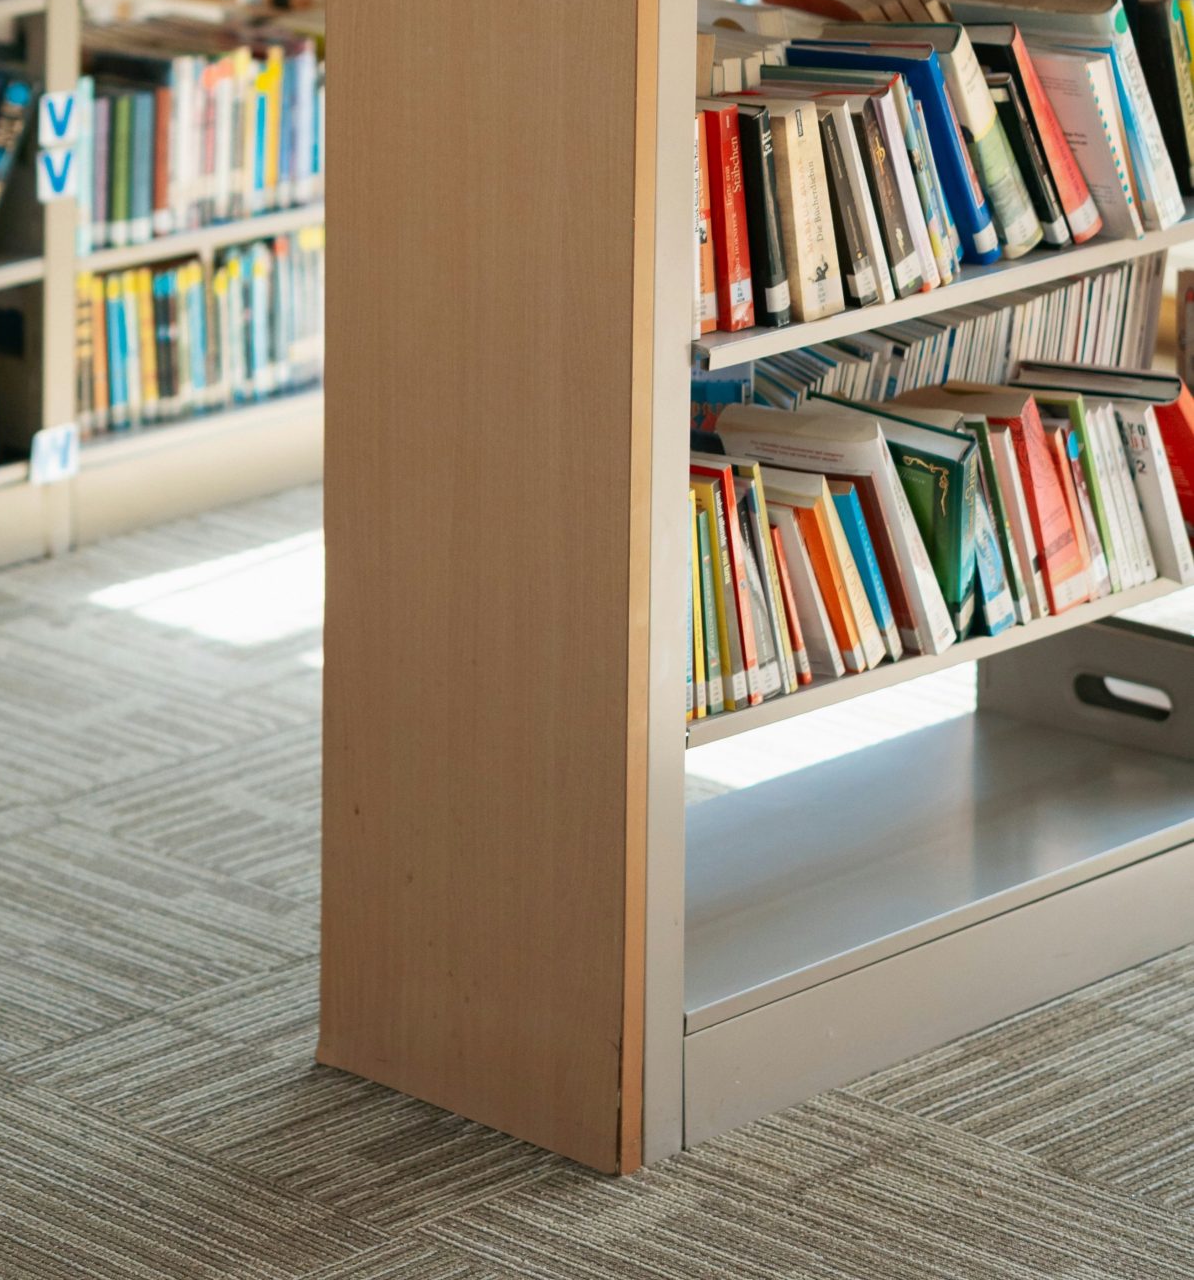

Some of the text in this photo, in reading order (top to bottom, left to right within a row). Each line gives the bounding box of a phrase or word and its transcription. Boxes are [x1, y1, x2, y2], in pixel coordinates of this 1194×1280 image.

[45, 95, 74, 137] V
[43, 150, 73, 193] V
[729, 135, 742, 193] Stäbchen
[808, 160, 824, 242] Die Bücherdiebin
[714, 490, 731, 585] isabel allende eva luna
